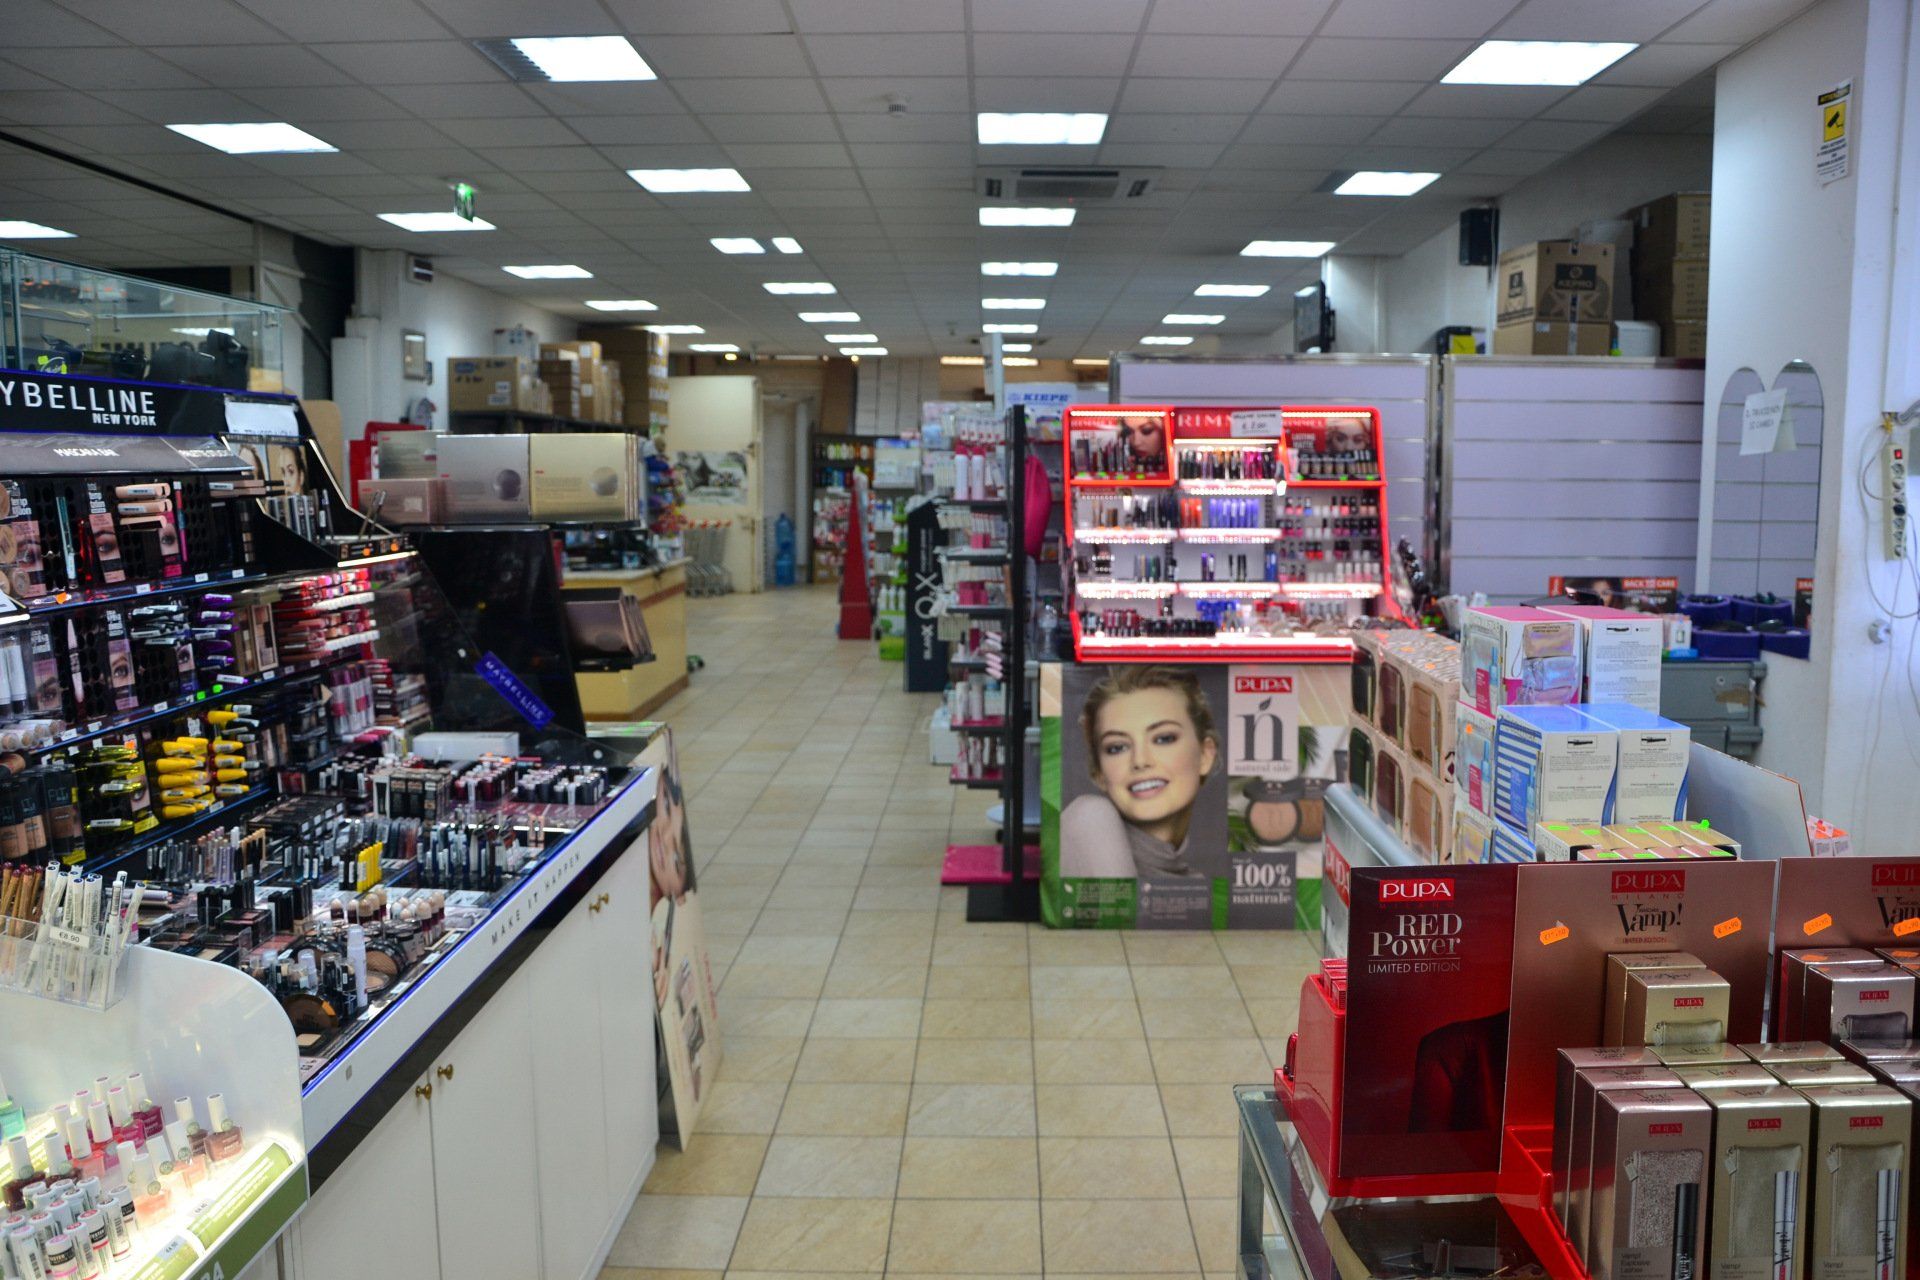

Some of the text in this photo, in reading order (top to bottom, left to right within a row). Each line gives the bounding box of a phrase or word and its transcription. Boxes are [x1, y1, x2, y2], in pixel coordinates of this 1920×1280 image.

[0, 381, 156, 414] YBELLINE
[1023, 392, 1069, 402] KIEPE
[92, 413, 157, 427] NEW YORK
[1178, 413, 1233, 428] RIM
[485, 660, 545, 720] MAYBELLINE
[1236, 678, 1292, 692] PUPA
[1232, 863, 1292, 888] 100%
[1614, 873, 1682, 889] PUPA
[491, 852, 580, 944] MAKE IT HAPPEN
[1232, 892, 1291, 904] naturale
[1382, 882, 1452, 899] PUPA
[1395, 913, 1463, 937] RED
[1616, 902, 1683, 936] Vamp!
[1368, 961, 1461, 975] LIMITED EDITION
[1674, 998, 1704, 1007] PUPA
[1720, 1262, 1741, 1270] Vamp!
